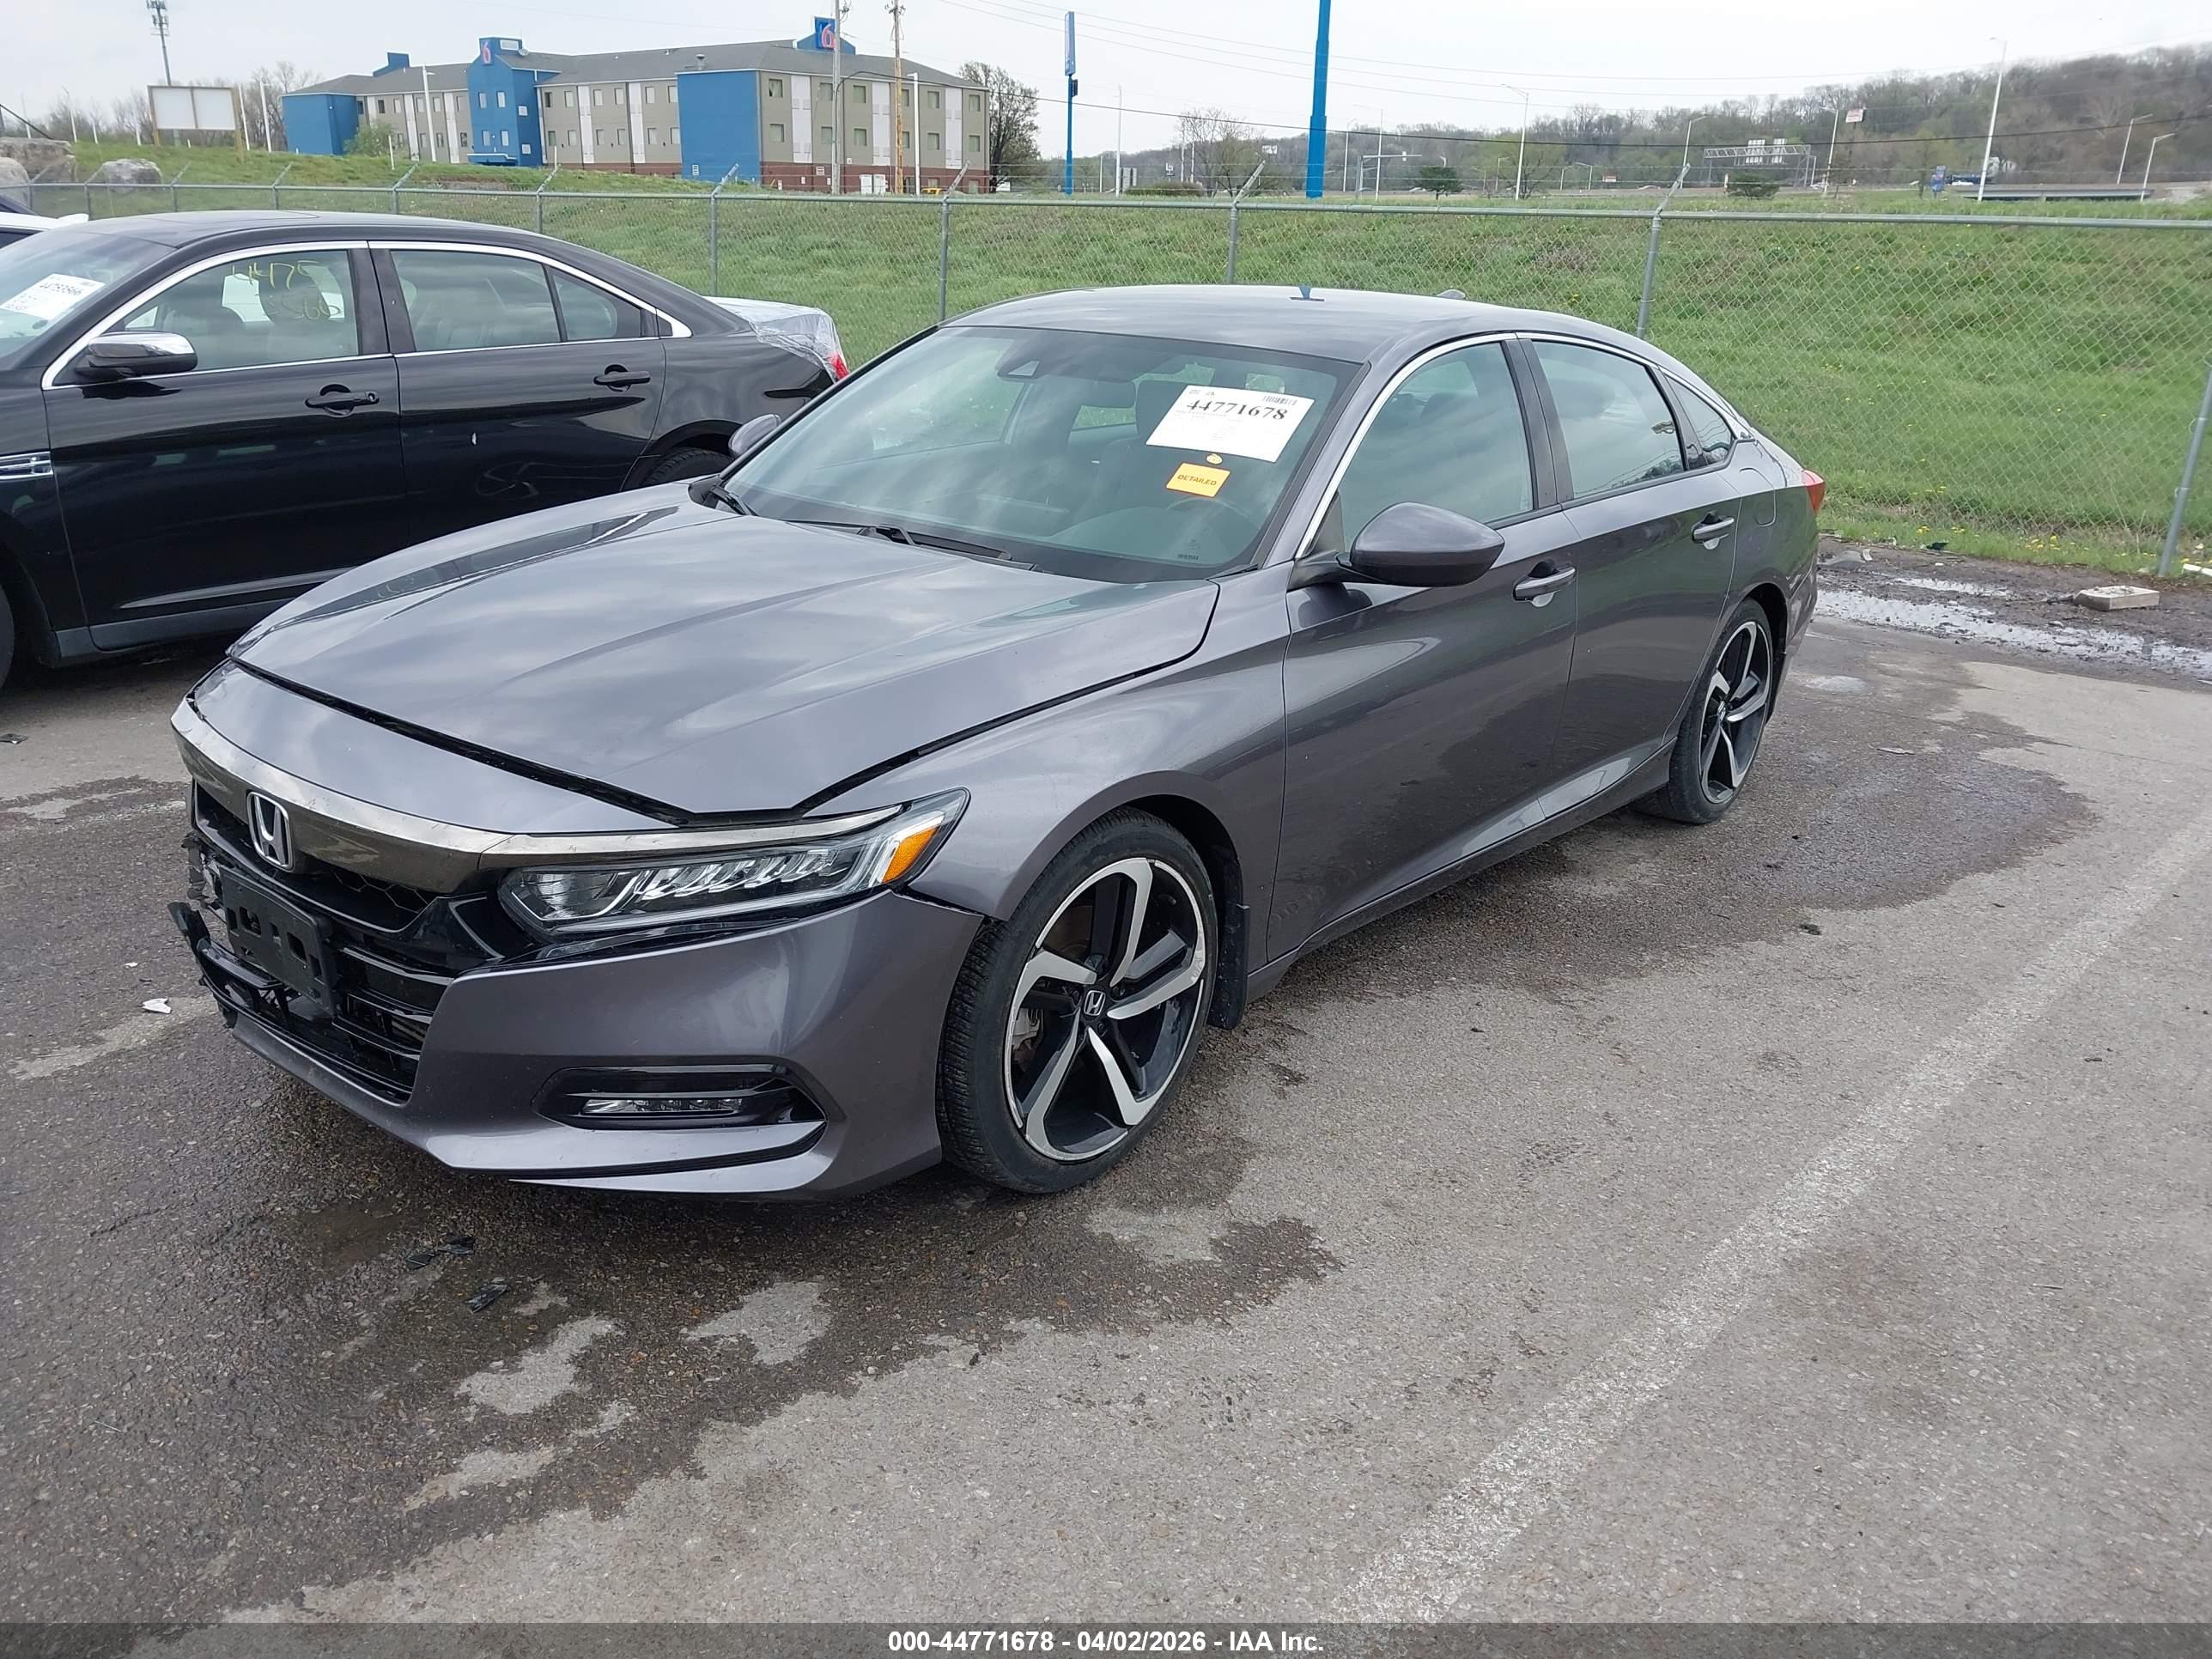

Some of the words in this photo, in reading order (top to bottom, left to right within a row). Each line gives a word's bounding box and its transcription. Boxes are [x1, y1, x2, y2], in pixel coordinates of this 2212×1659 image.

[822, 23, 836, 49] 6
[482, 40, 491, 64] 6
[1186, 399, 1288, 421] 44771678
[1176, 473, 1218, 487] DETAILED
